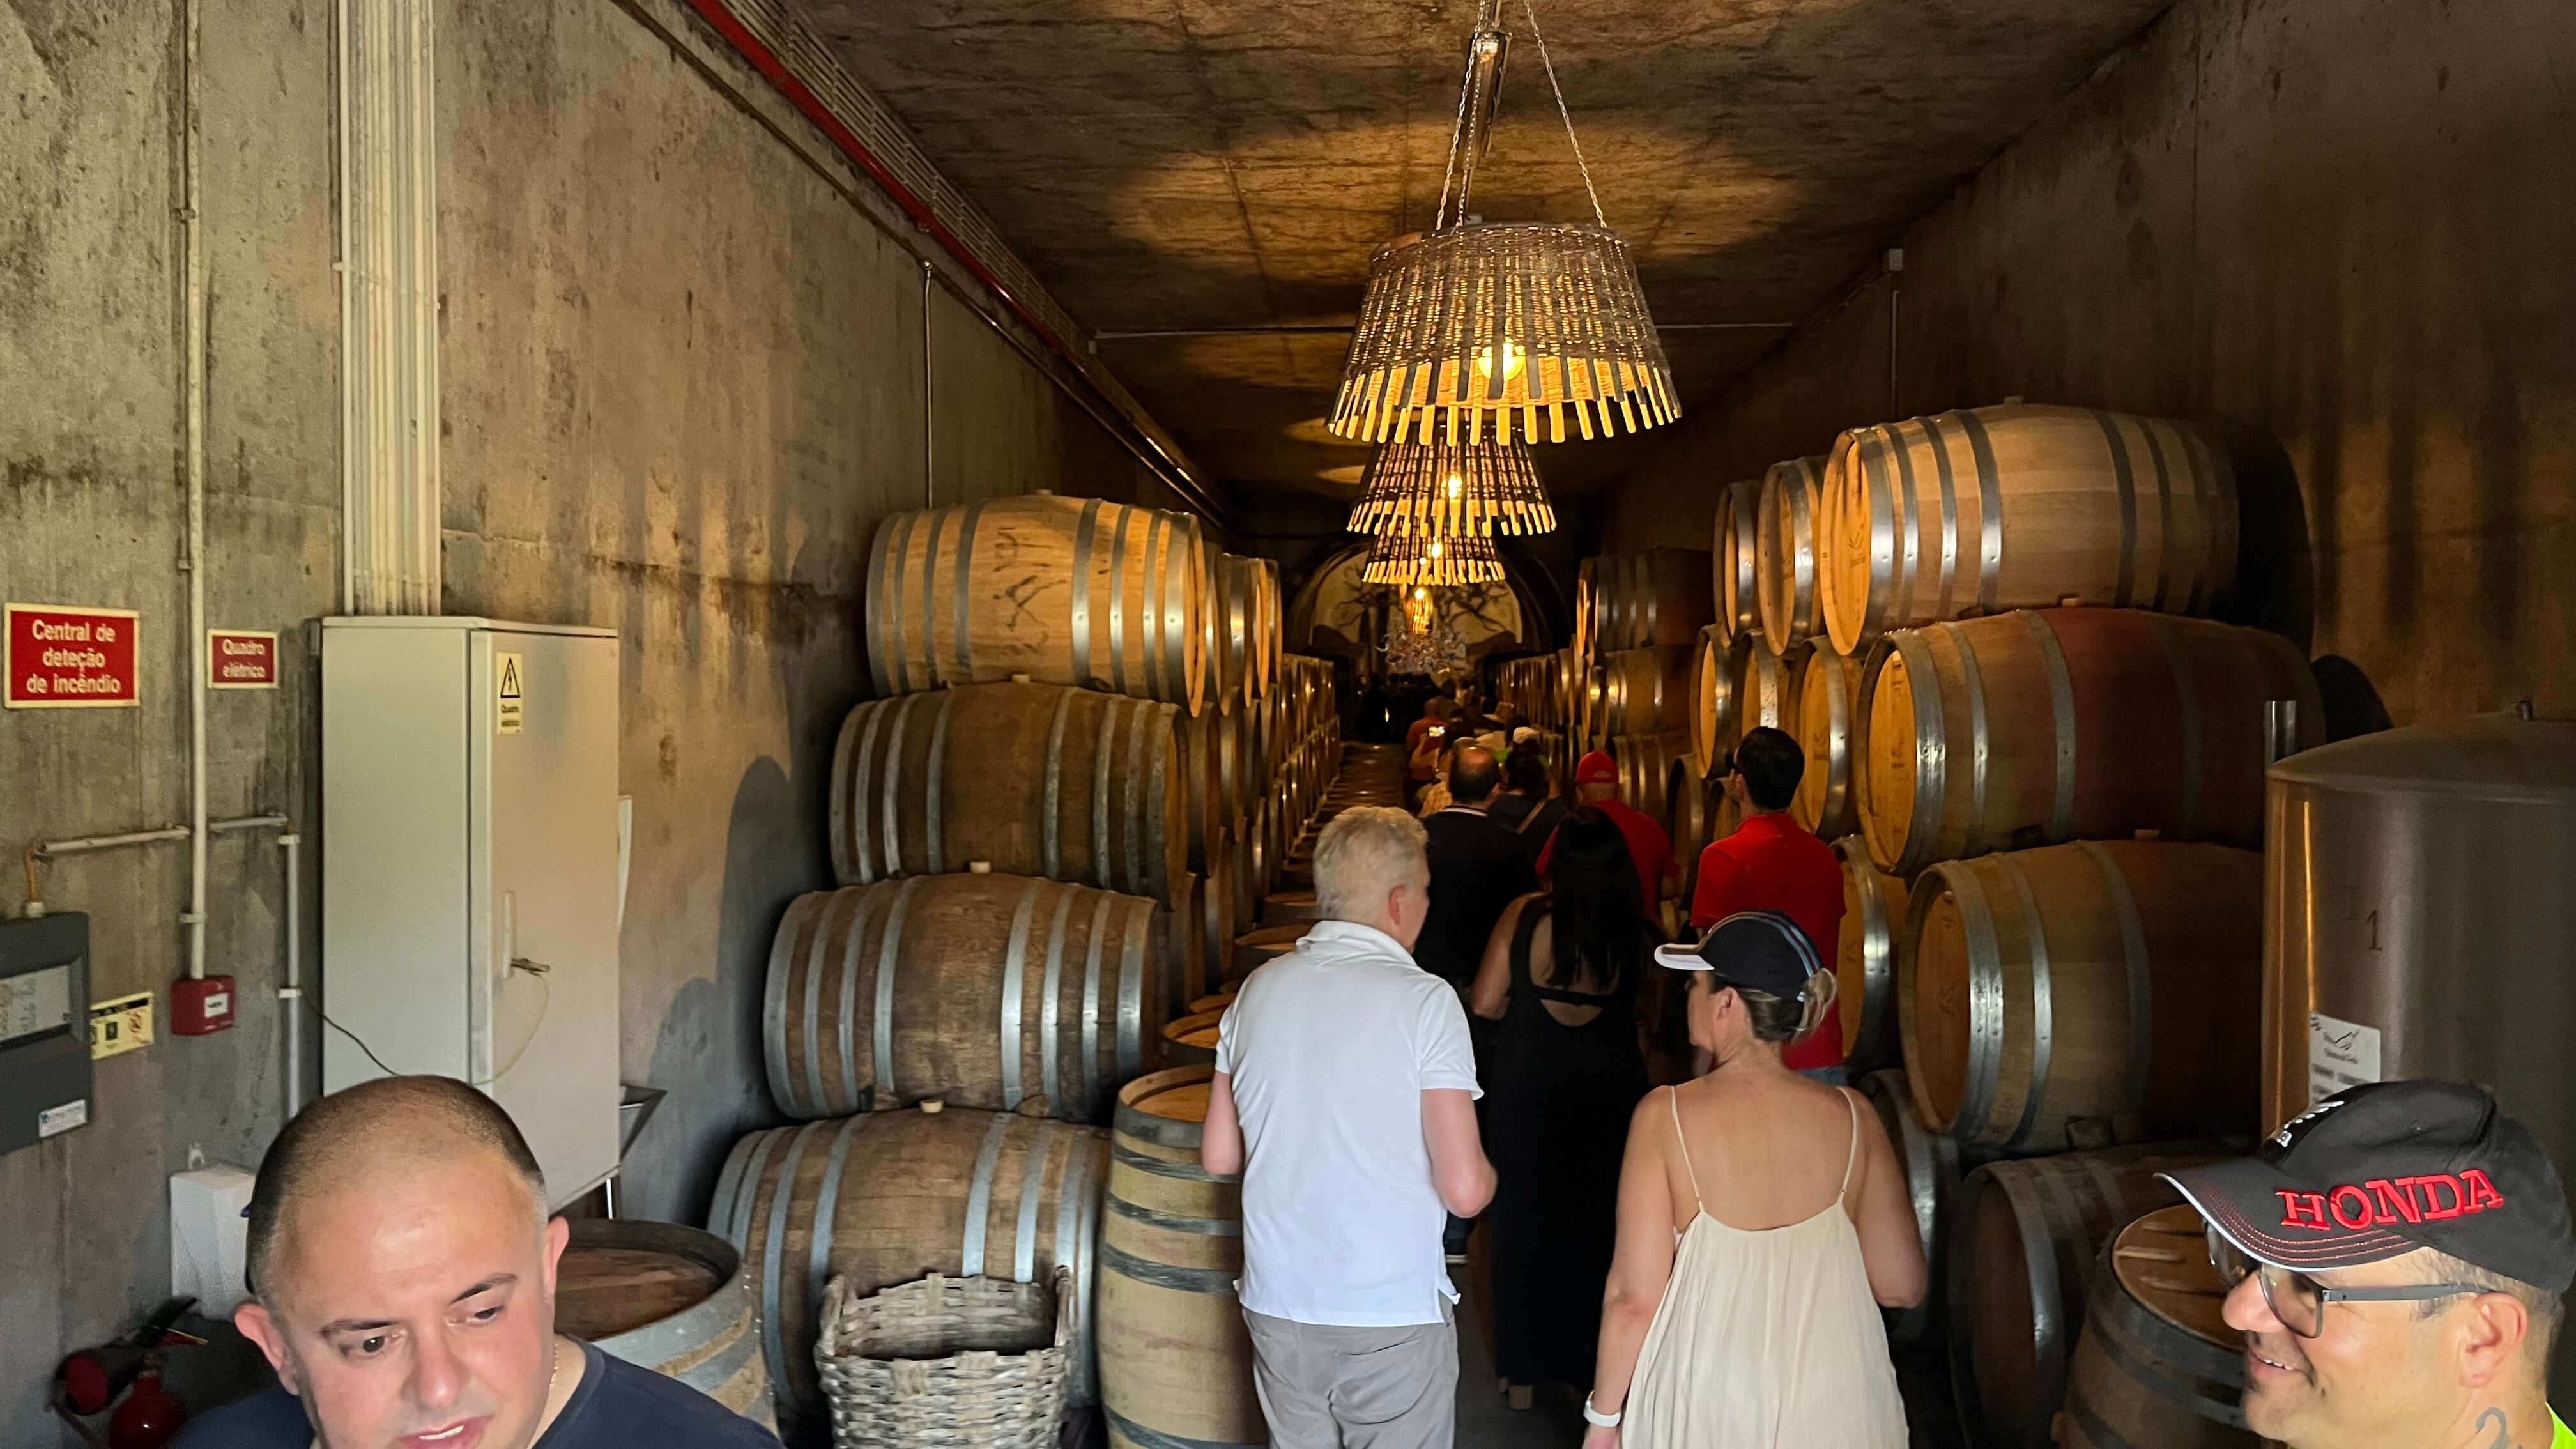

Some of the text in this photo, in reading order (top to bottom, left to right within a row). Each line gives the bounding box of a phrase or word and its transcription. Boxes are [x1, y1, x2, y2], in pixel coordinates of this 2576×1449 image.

[32, 619, 116, 643] Central de
[42, 647, 105, 671] deteção
[222, 639, 265, 656] Quadro
[26, 673, 121, 694] de incêndio
[2275, 1168, 2505, 1231] HONDA
